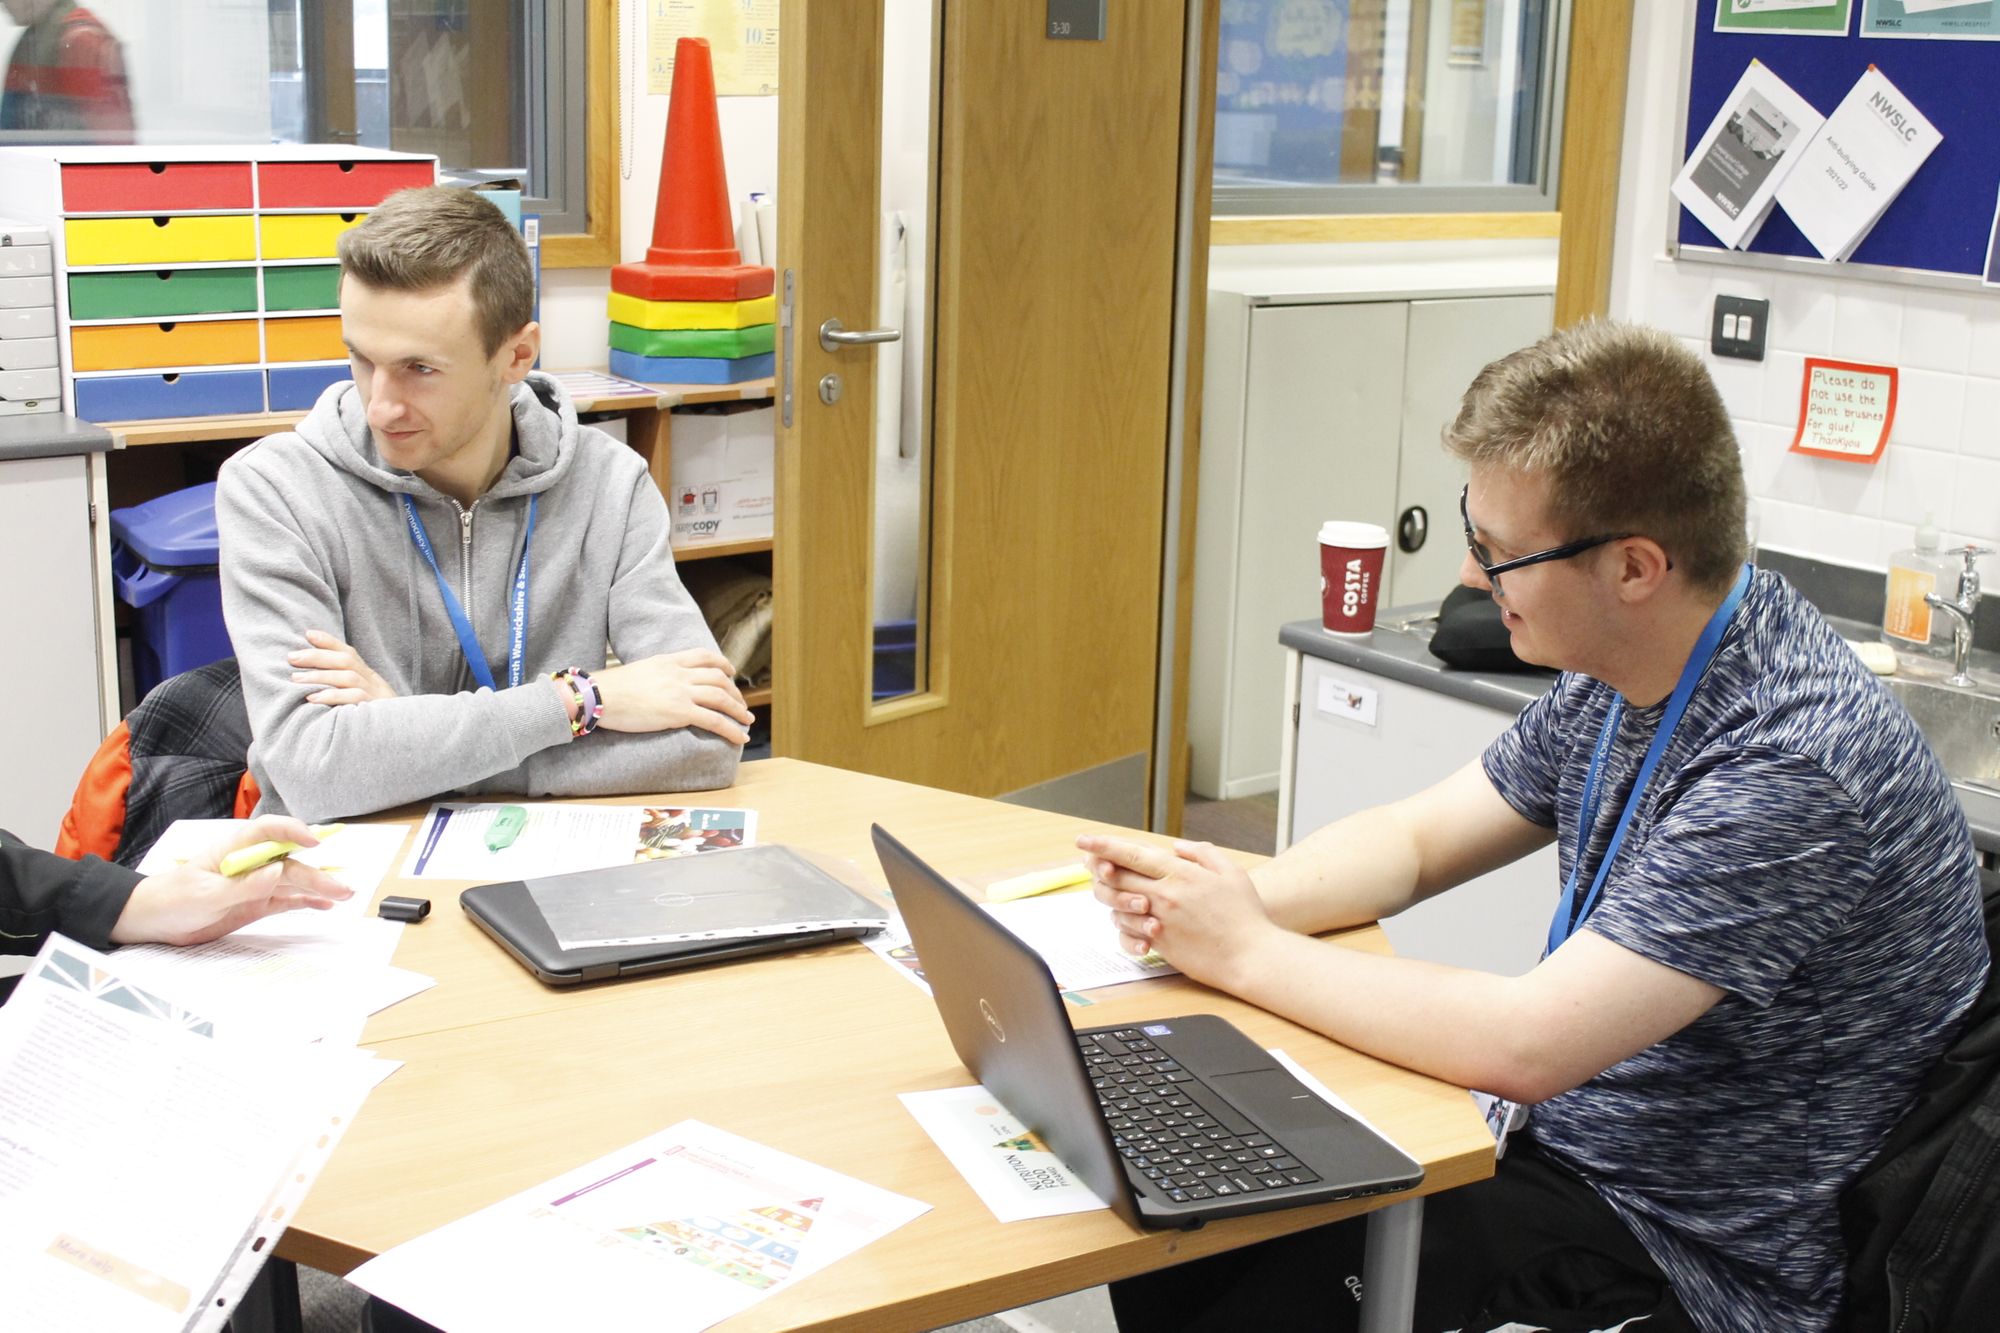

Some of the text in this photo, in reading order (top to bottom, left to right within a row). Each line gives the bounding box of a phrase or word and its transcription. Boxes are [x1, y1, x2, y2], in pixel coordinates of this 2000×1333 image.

[1051, 22, 1070, 34] 3-30
[1876, 19, 1902, 27] NWSLC
[1870, 91, 1917, 142] NWSLC
[1859, 171, 1877, 191] Guide
[1715, 192, 1740, 215] NWSLC
[1813, 370, 1875, 390] Please do
[1811, 388, 1876, 405] not use the
[516, 579, 526, 589] &
[1342, 559, 1362, 618] COSTA
[1360, 572, 1370, 604] COFFEE
[512, 591, 525, 659] Warwickshire
[1597, 703, 1620, 760] Democracy,
[1587, 761, 1606, 811] Individual
[1003, 1155, 1044, 1190] NUTRITION
[1033, 1169, 1059, 1188] FOOD
